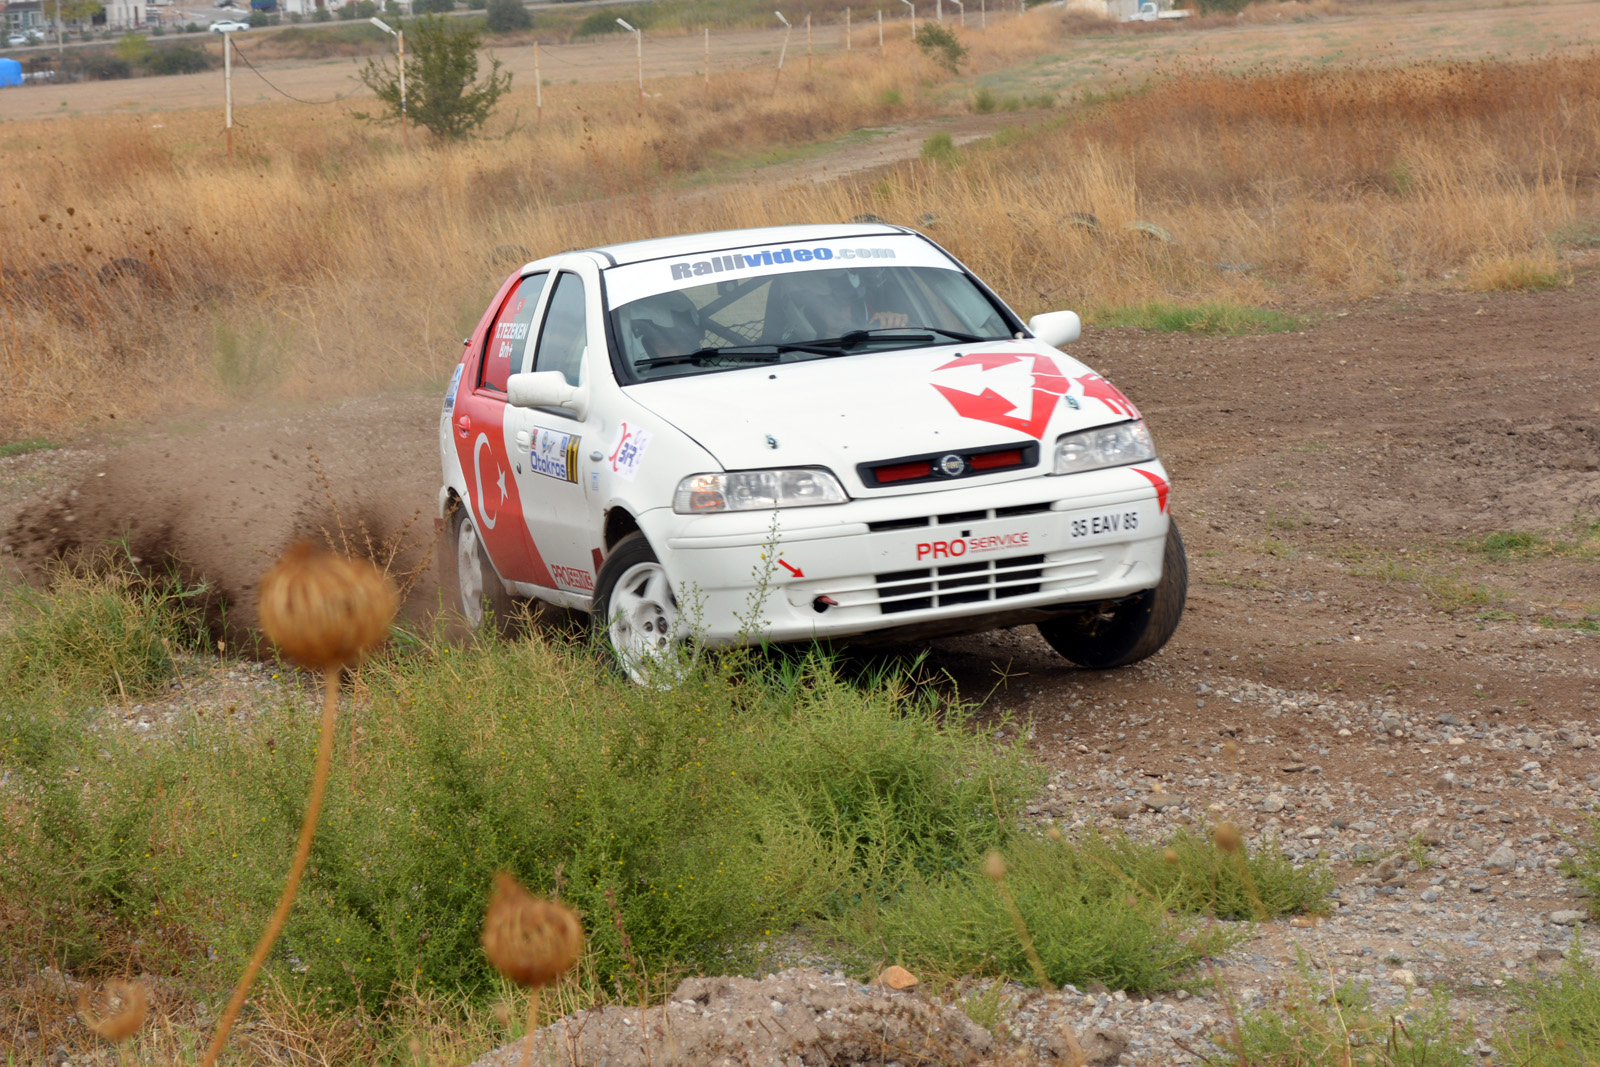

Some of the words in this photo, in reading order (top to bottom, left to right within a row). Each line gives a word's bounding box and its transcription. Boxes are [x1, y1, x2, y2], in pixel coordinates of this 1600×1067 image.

[670, 247, 896, 280] Rallivideo.com
[530, 451, 567, 478] Otokros
[1071, 519, 1088, 538] 35
[1092, 513, 1120, 535] EAV
[1123, 511, 1139, 530] 85
[916, 538, 967, 561] PRO
[969, 531, 1029, 550] SERVICE
